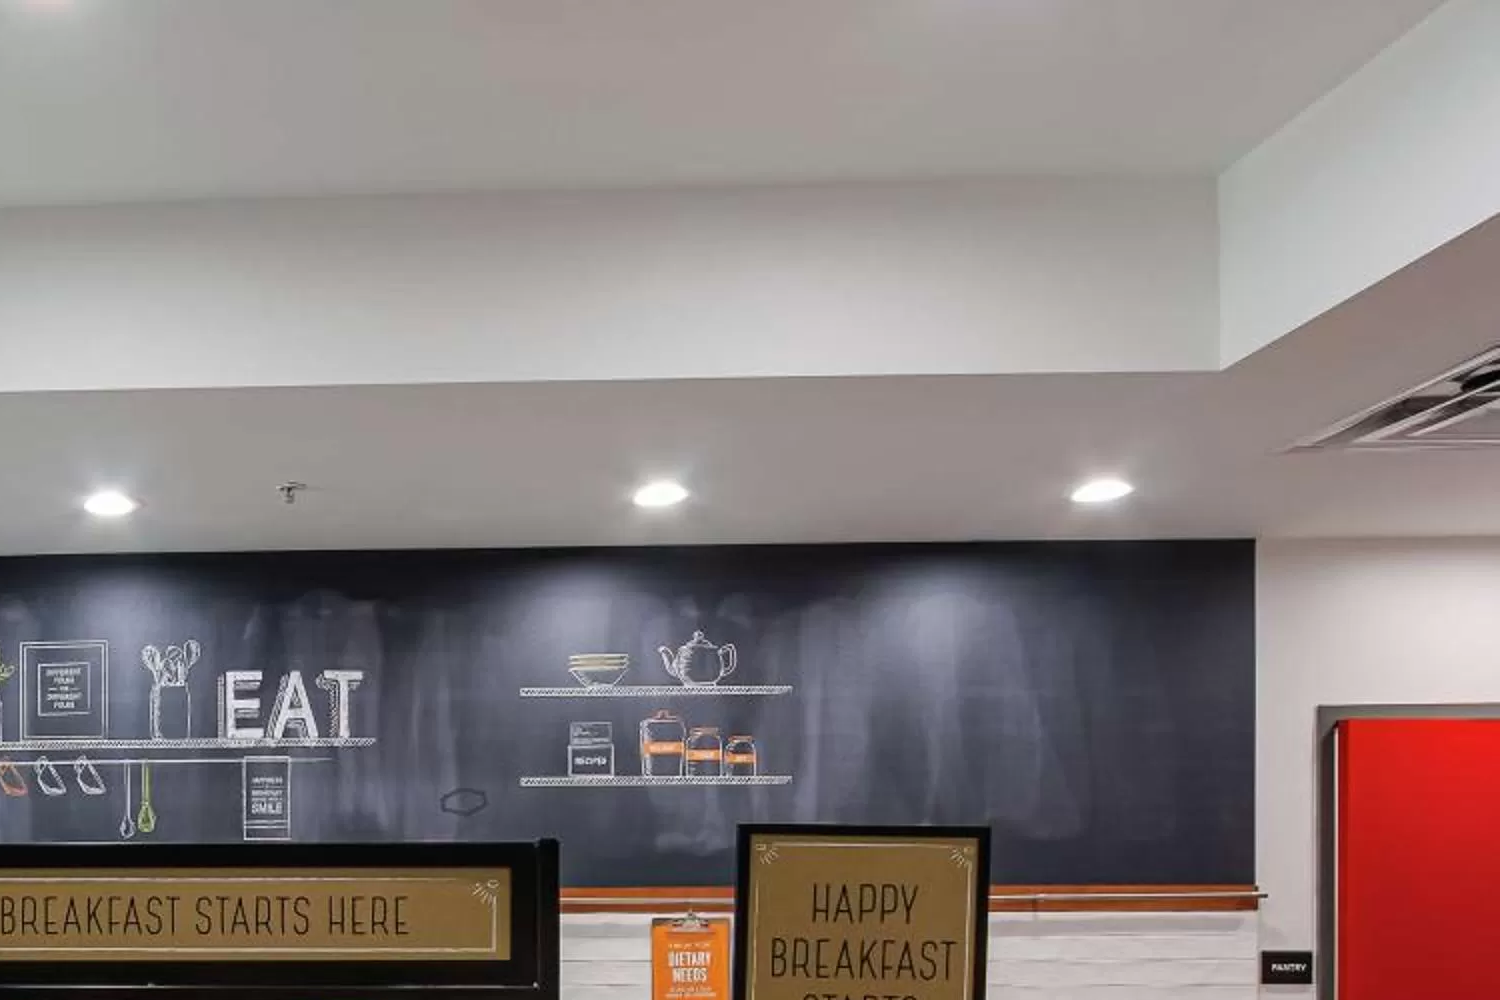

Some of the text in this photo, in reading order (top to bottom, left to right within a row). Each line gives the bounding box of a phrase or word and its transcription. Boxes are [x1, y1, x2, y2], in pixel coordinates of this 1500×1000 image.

[217, 669, 364, 739] EAT
[1, 896, 181, 936] BREAKFAST
[195, 896, 312, 936] STARTS
[329, 896, 410, 936] HERE
[811, 883, 919, 924] HAPPY
[667, 951, 712, 967] DIETARY
[672, 967, 708, 983] NEEDS
[770, 936, 958, 981] BREAKFAST
[1271, 963, 1307, 973] PANTRY
